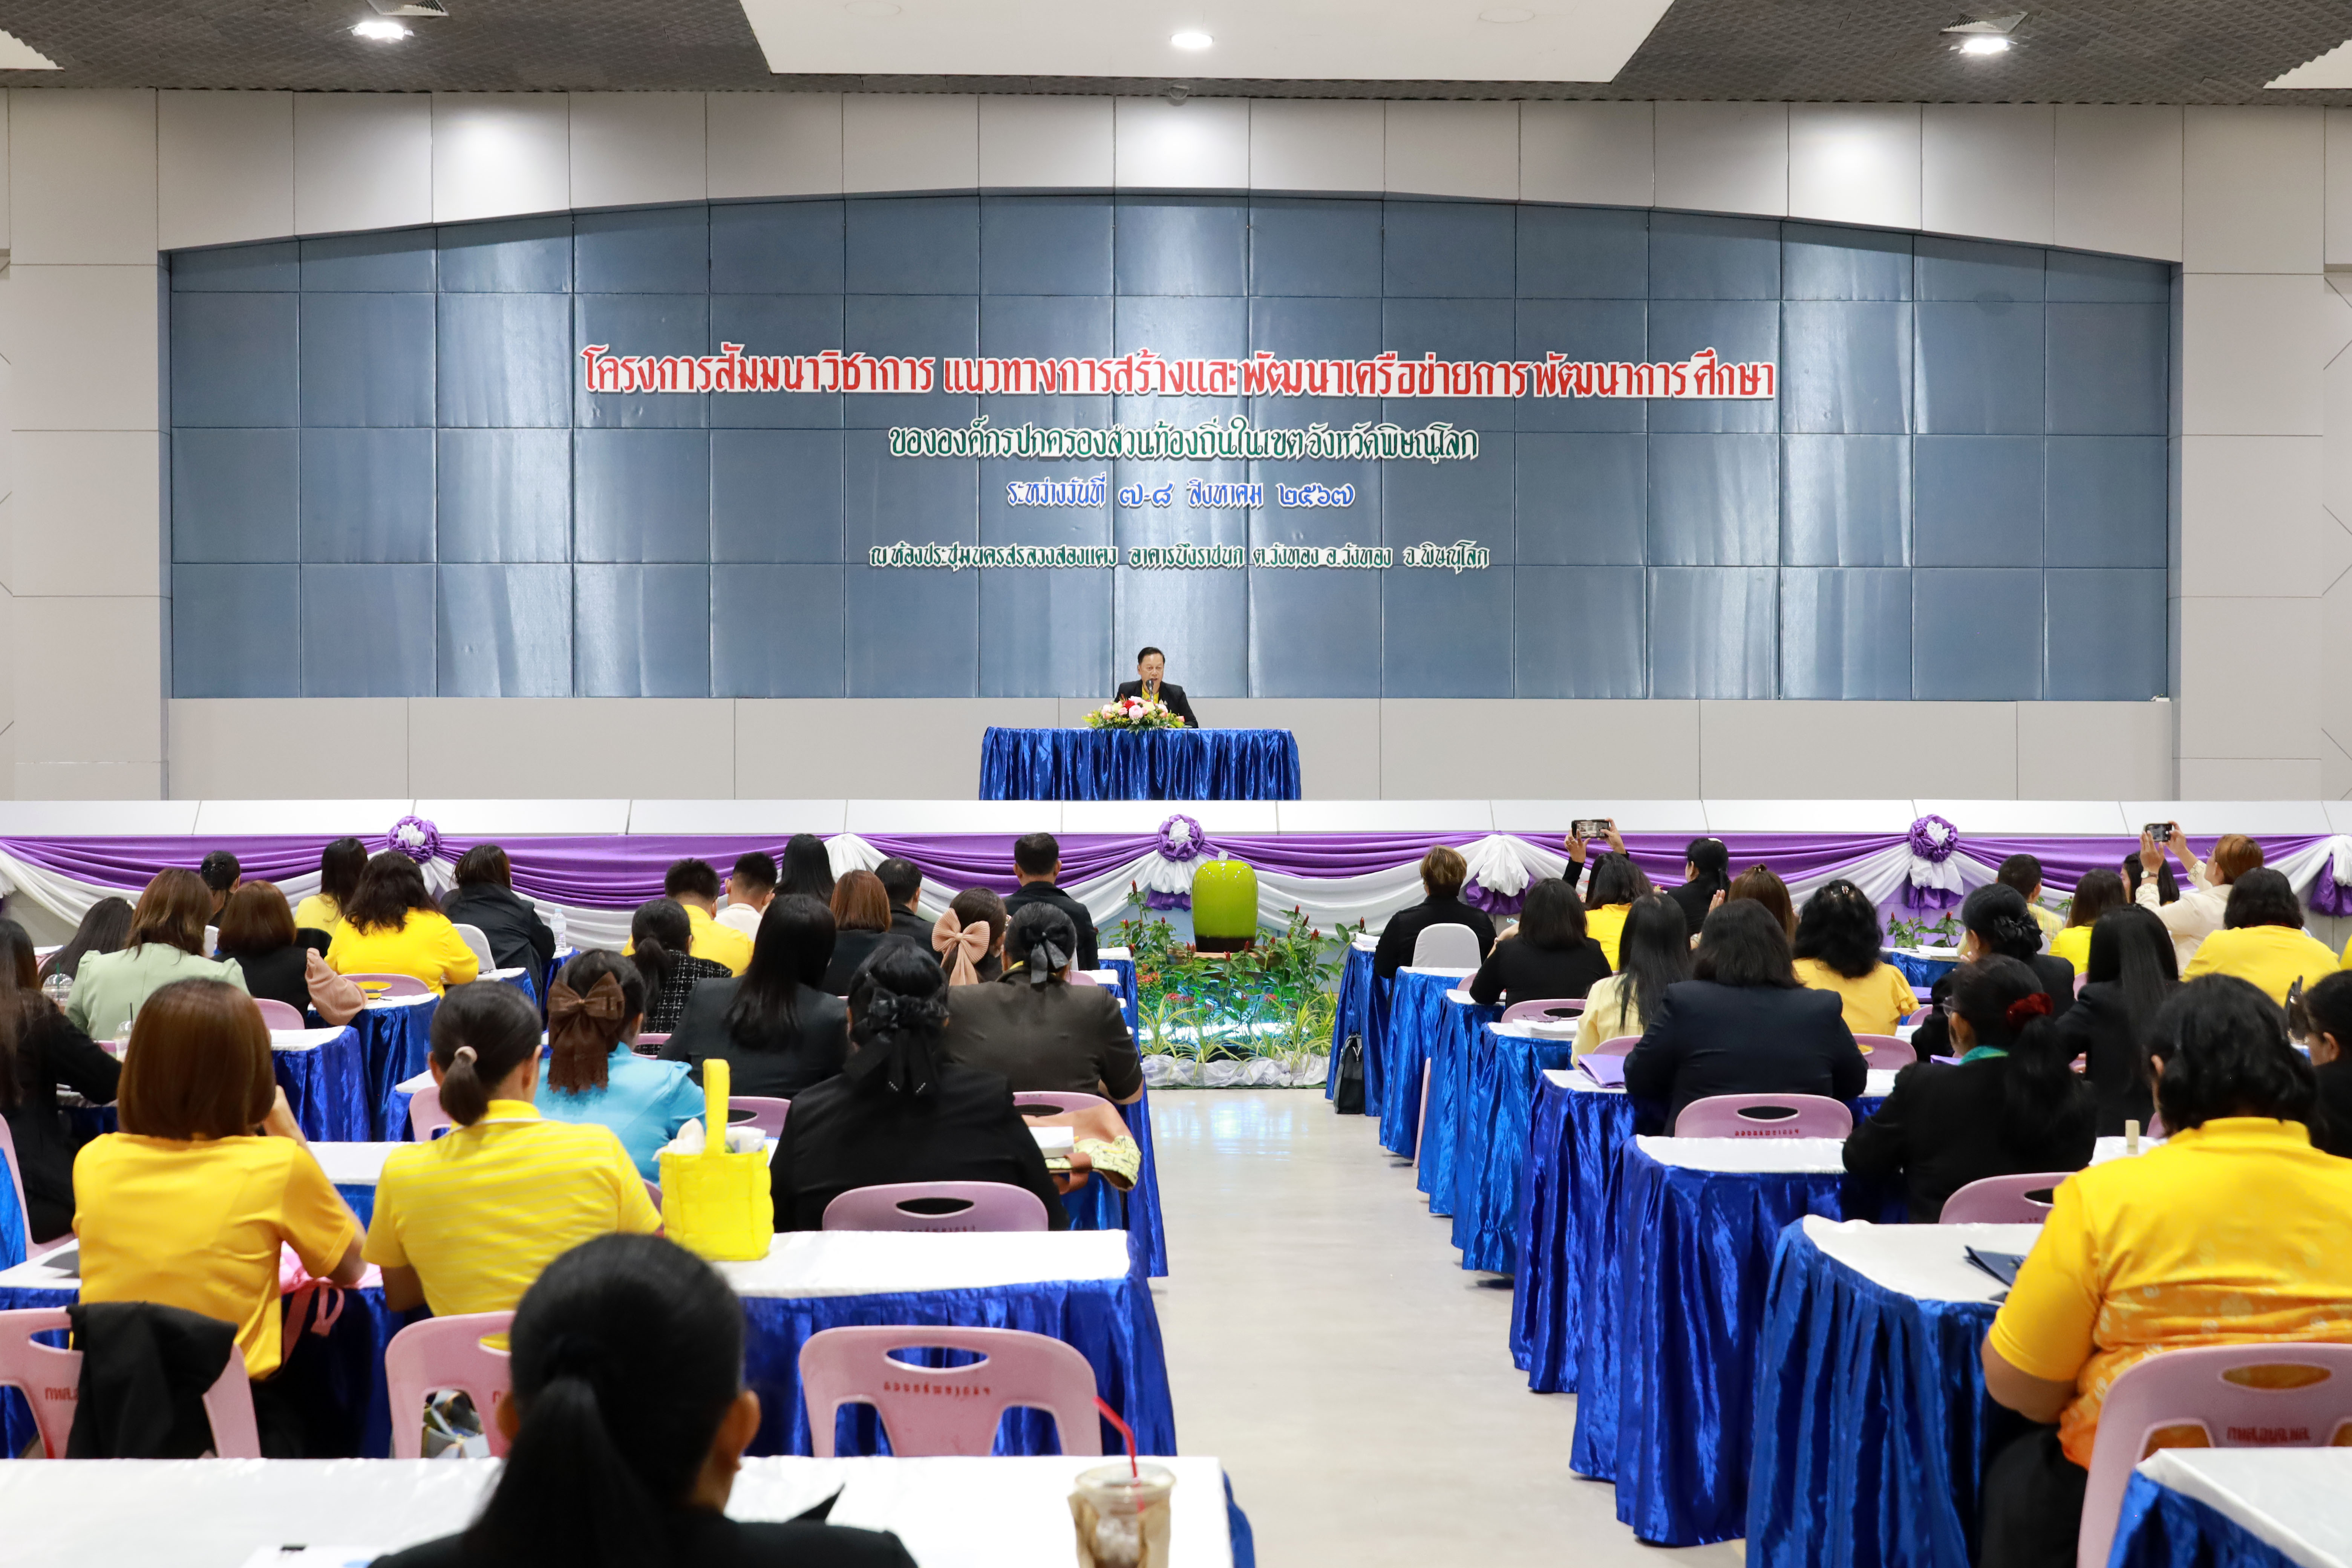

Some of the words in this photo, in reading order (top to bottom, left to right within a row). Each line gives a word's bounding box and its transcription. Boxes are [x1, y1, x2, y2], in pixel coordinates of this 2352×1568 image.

[581, 342, 935, 392] โครงการสัมมนาวิชาการ
[890, 416, 1477, 462] ขององค์กรปกครองส่วนท้องถิ่นในเขตจังหวัดพิษณุโลก
[1007, 473, 1106, 506] ระหว่างวันที่
[1119, 484, 1174, 505] ๗-๘
[1188, 480, 1263, 506] สิงหาคม
[1279, 483, 1355, 506] ๒๕๖๗
[1131, 543, 1245, 567] อาคารบึงราชนก
[1406, 543, 1487, 571] จ.พิษณุโลก
